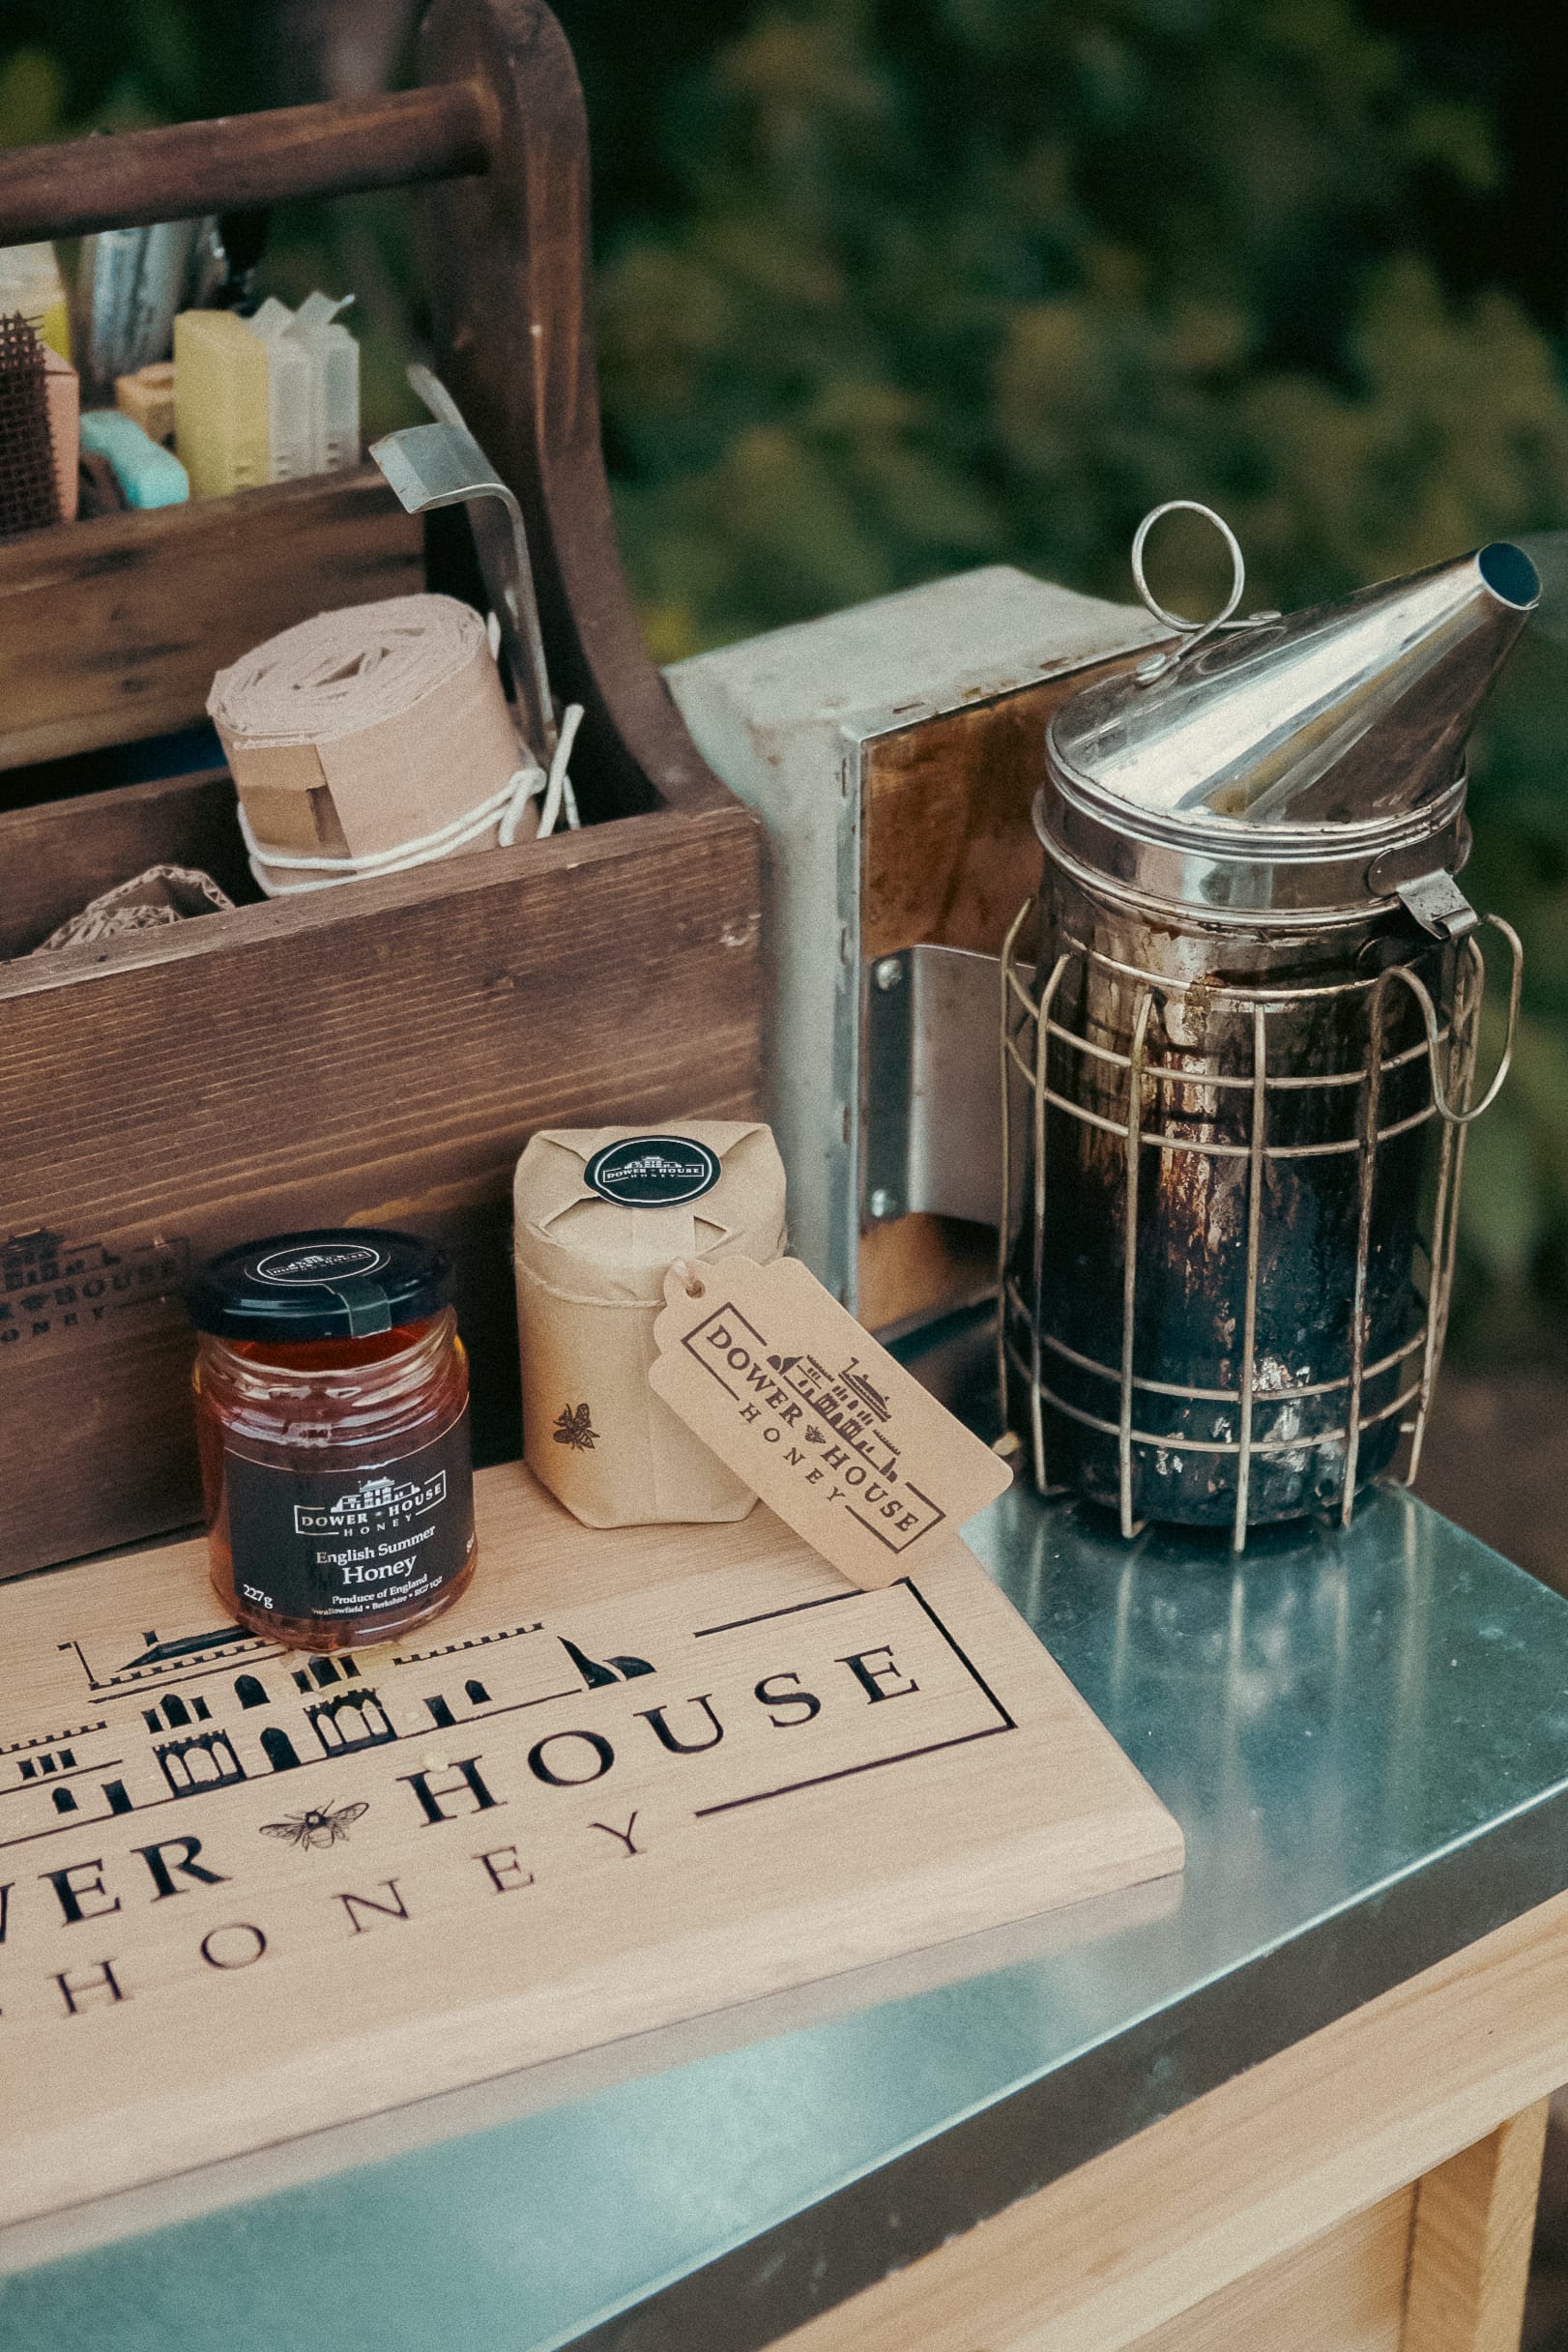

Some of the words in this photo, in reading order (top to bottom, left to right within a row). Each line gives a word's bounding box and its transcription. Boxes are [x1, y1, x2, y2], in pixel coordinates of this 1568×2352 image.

[607, 1168, 647, 1179] DOWER
[0, 1306, 104, 1342] ONEY
[707, 1324, 803, 1428] DOWER
[821, 1445, 919, 1532] HOUSE
[739, 1402, 846, 1502] HONEY
[302, 1513, 368, 1526] DOWER
[389, 1483, 442, 1517] HOUSE
[343, 1514, 413, 1537] HONEY
[316, 1548, 375, 1566] English
[378, 1525, 436, 1557] Summer
[342, 1555, 417, 1584] Honey
[243, 1583, 274, 1610] 227g
[332, 1593, 375, 1605] Produce
[377, 1588, 388, 1599] of
[390, 1573, 427, 1596] England
[396, 1645, 919, 1827] HOUSE
[47, 1811, 647, 2018] HONEY
